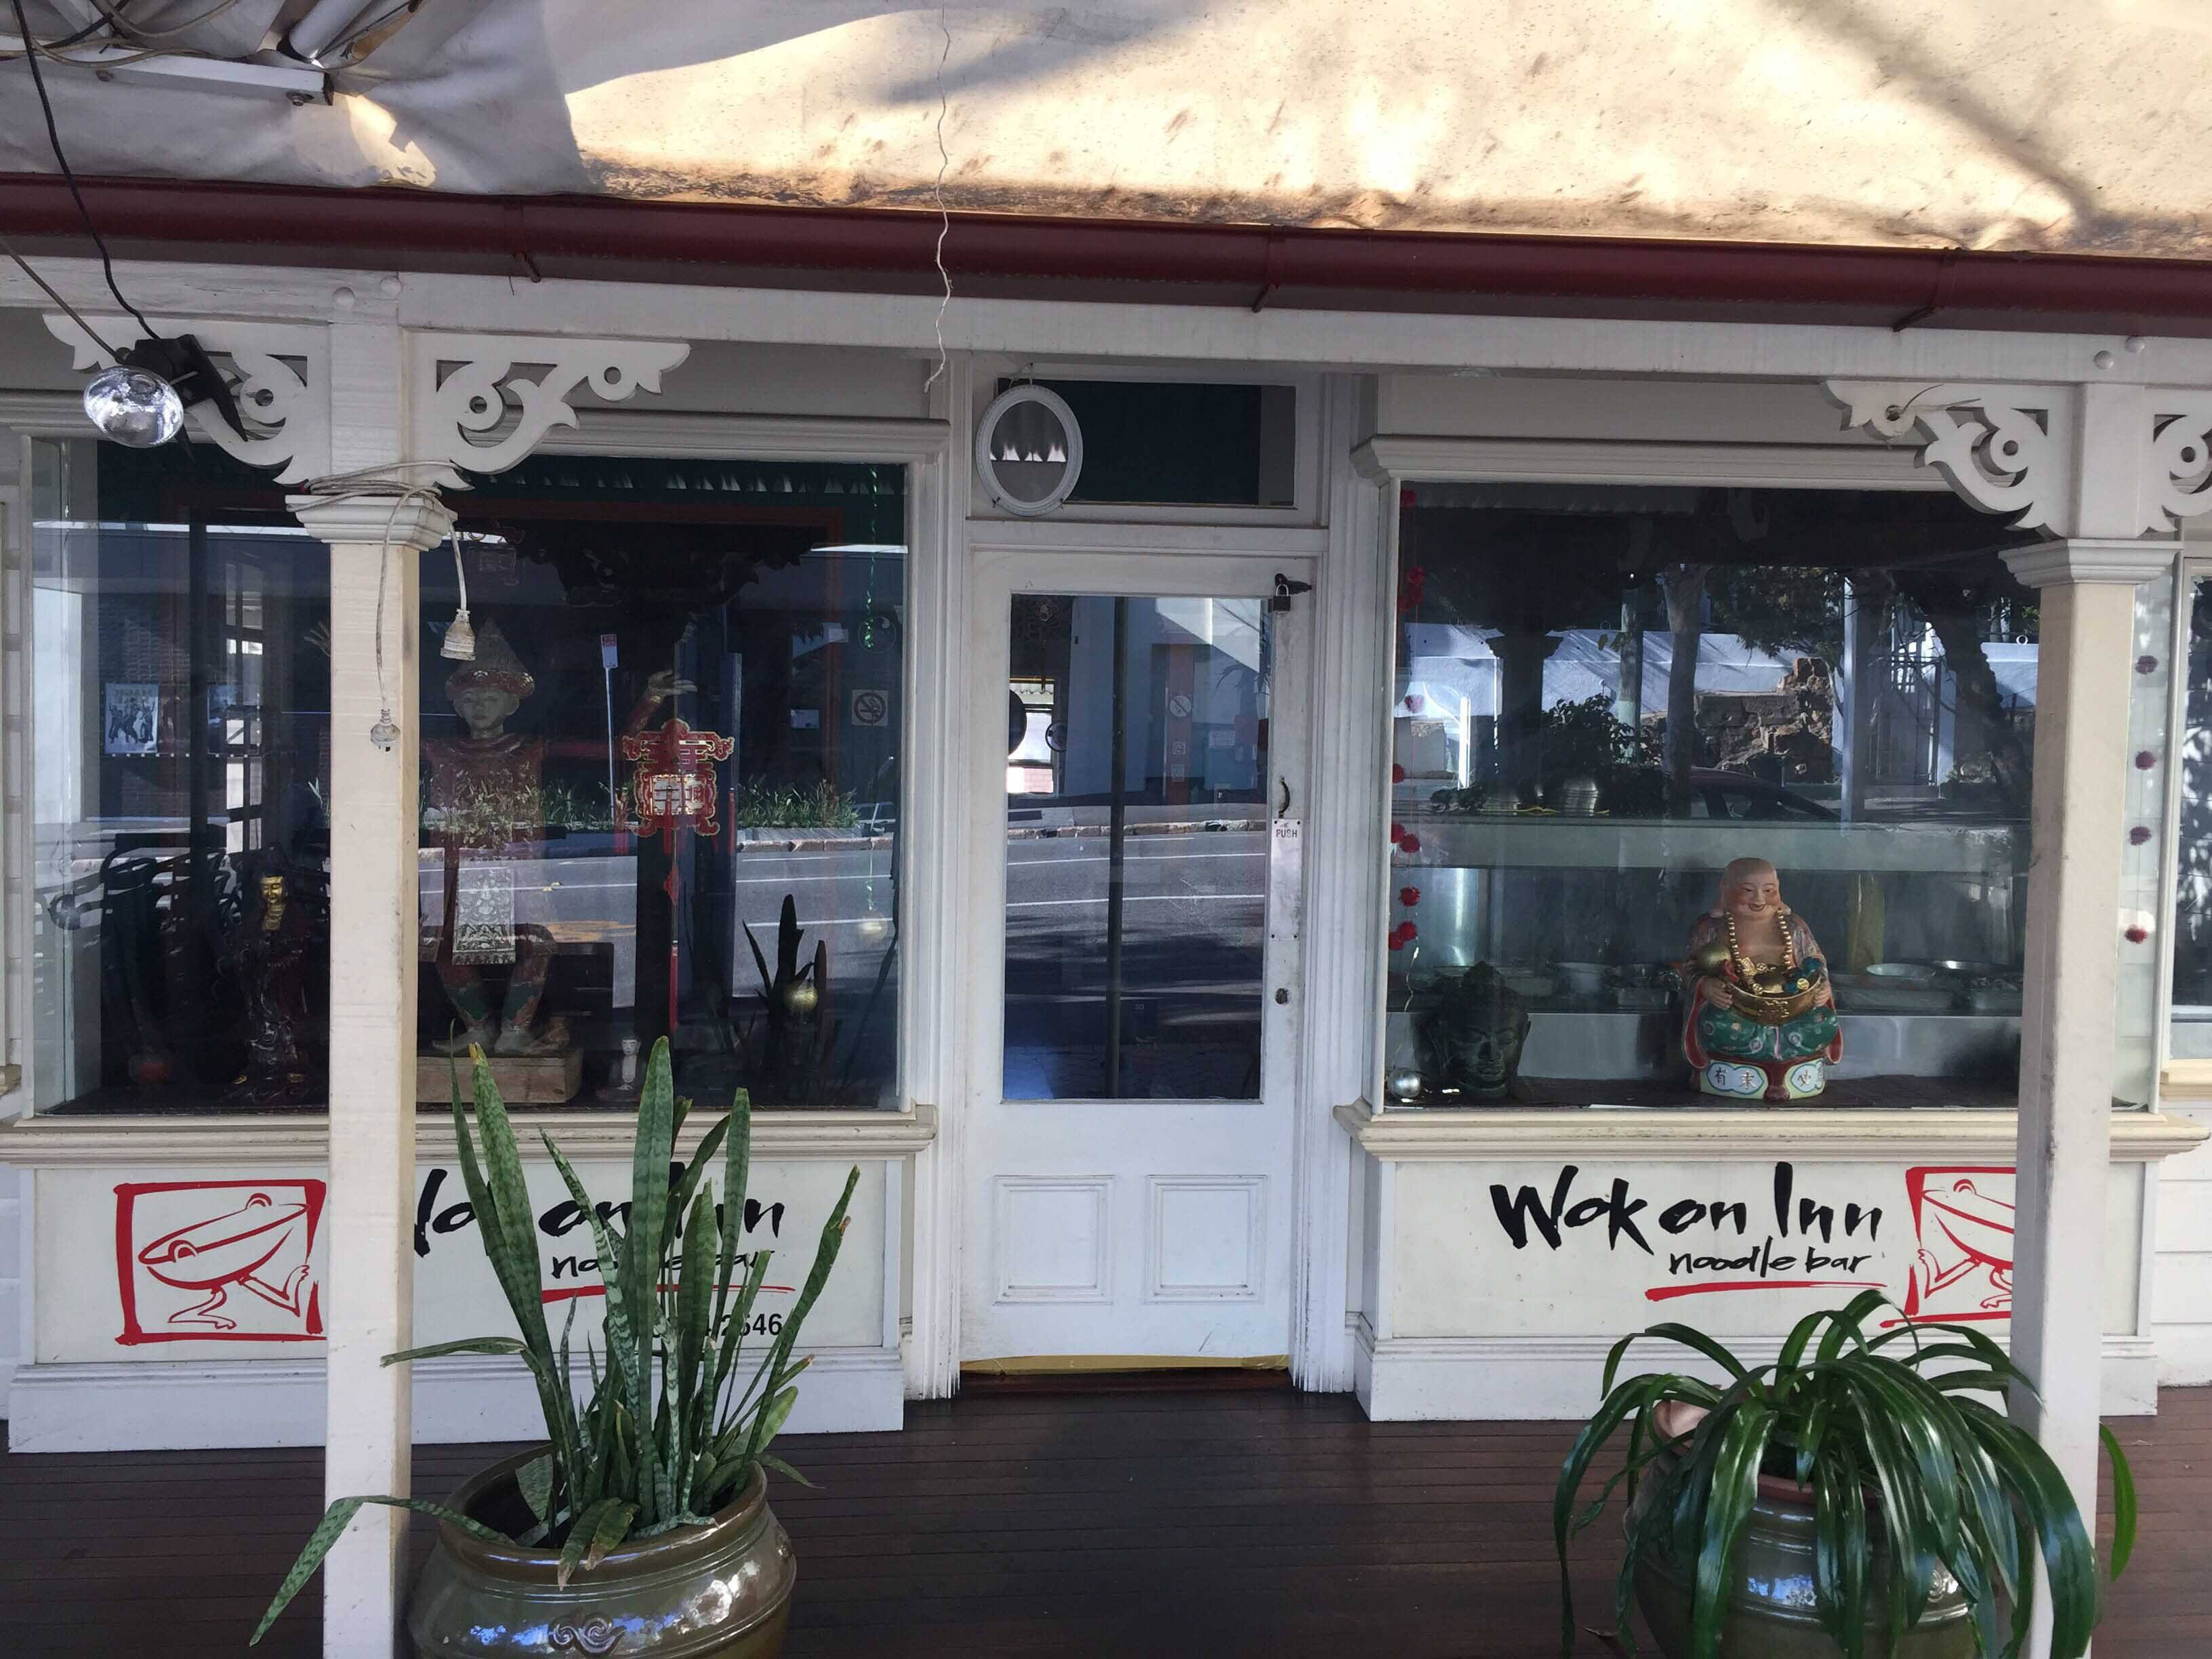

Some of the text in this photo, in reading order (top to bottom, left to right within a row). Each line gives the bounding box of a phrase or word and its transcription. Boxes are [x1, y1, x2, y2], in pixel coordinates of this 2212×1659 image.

[1275, 829, 1298, 838] PUSH
[1489, 1161, 1883, 1255] Wok on Inn
[1669, 1236, 1873, 1277] noodle bar
